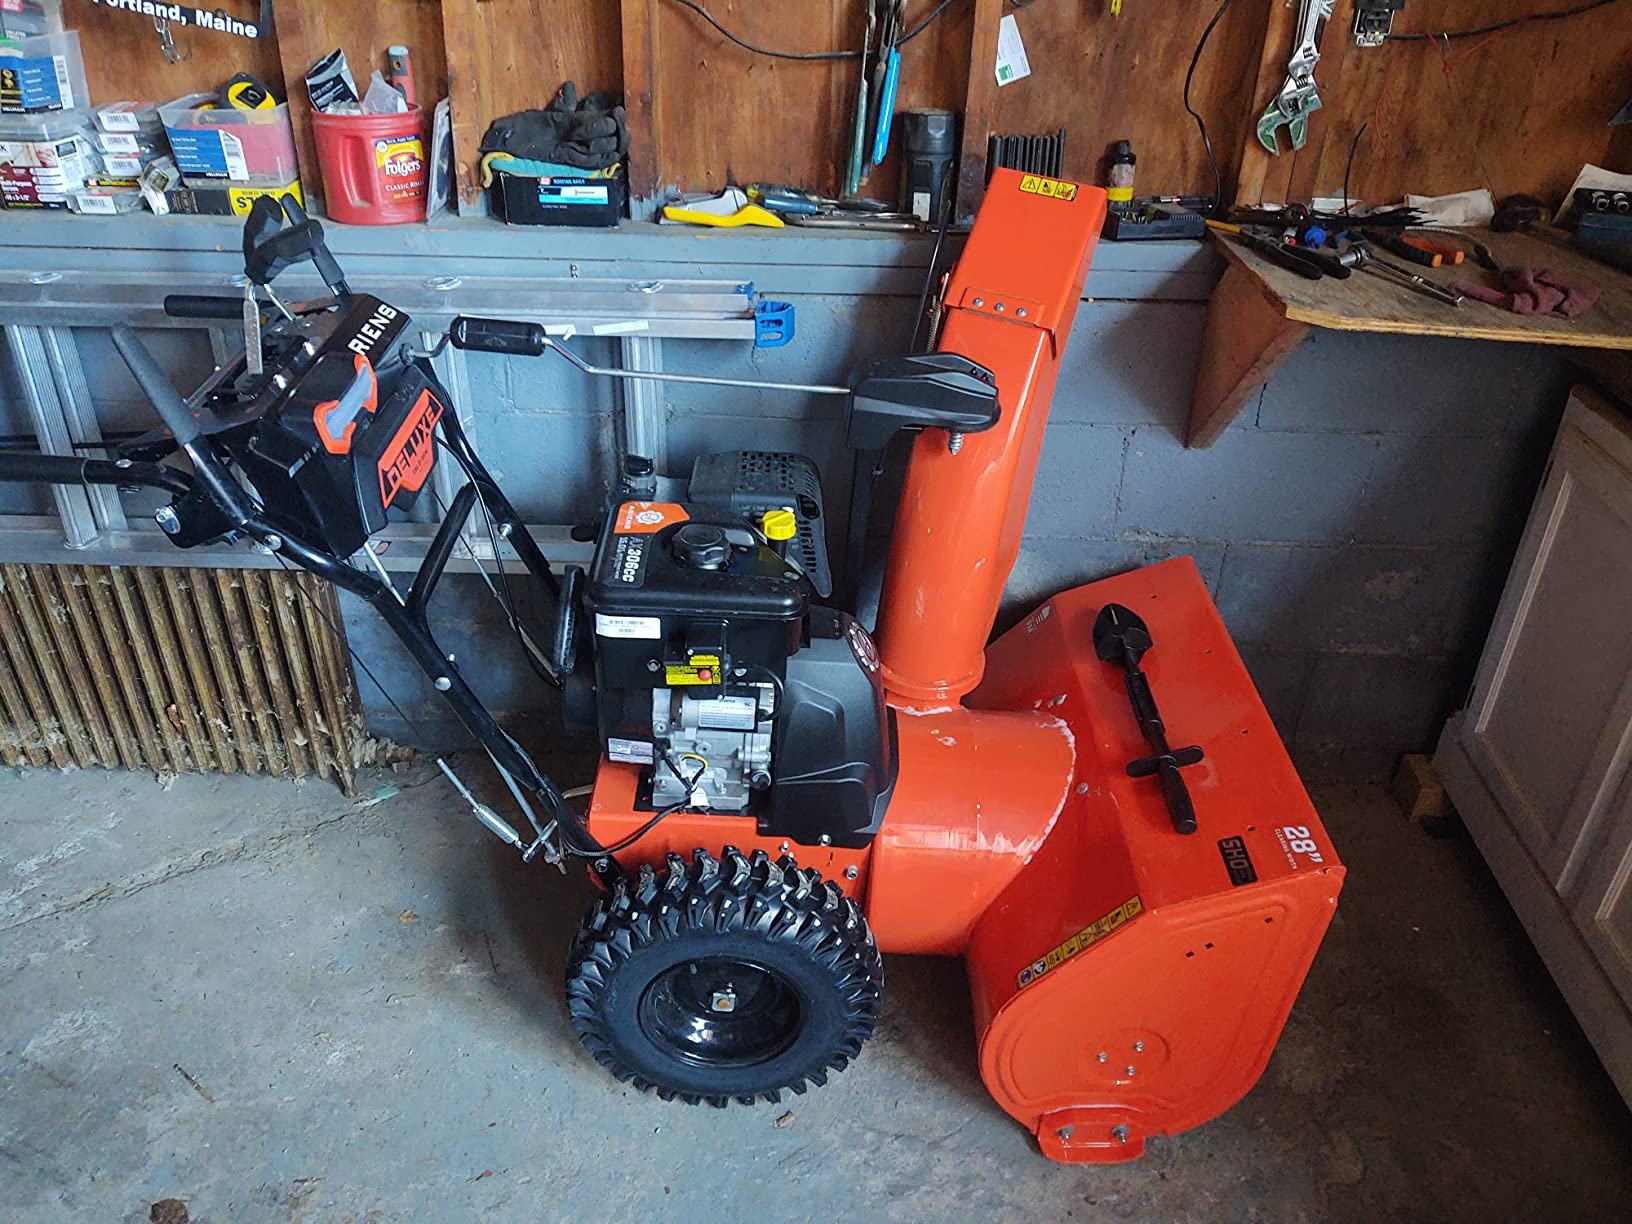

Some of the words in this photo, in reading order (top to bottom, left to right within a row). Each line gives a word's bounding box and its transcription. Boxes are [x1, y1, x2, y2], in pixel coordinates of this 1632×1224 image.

[92, 0, 187, 26] ortland,
[196, 10, 258, 38] Maine
[384, 159, 421, 176] Folgers
[385, 182, 410, 191] CLASSIC
[347, 304, 397, 356] RIENS
[386, 405, 436, 489] DELUXE
[624, 505, 635, 530] ARIENS
[1222, 839, 1249, 870] SHO
[1283, 826, 1323, 863] 28"
